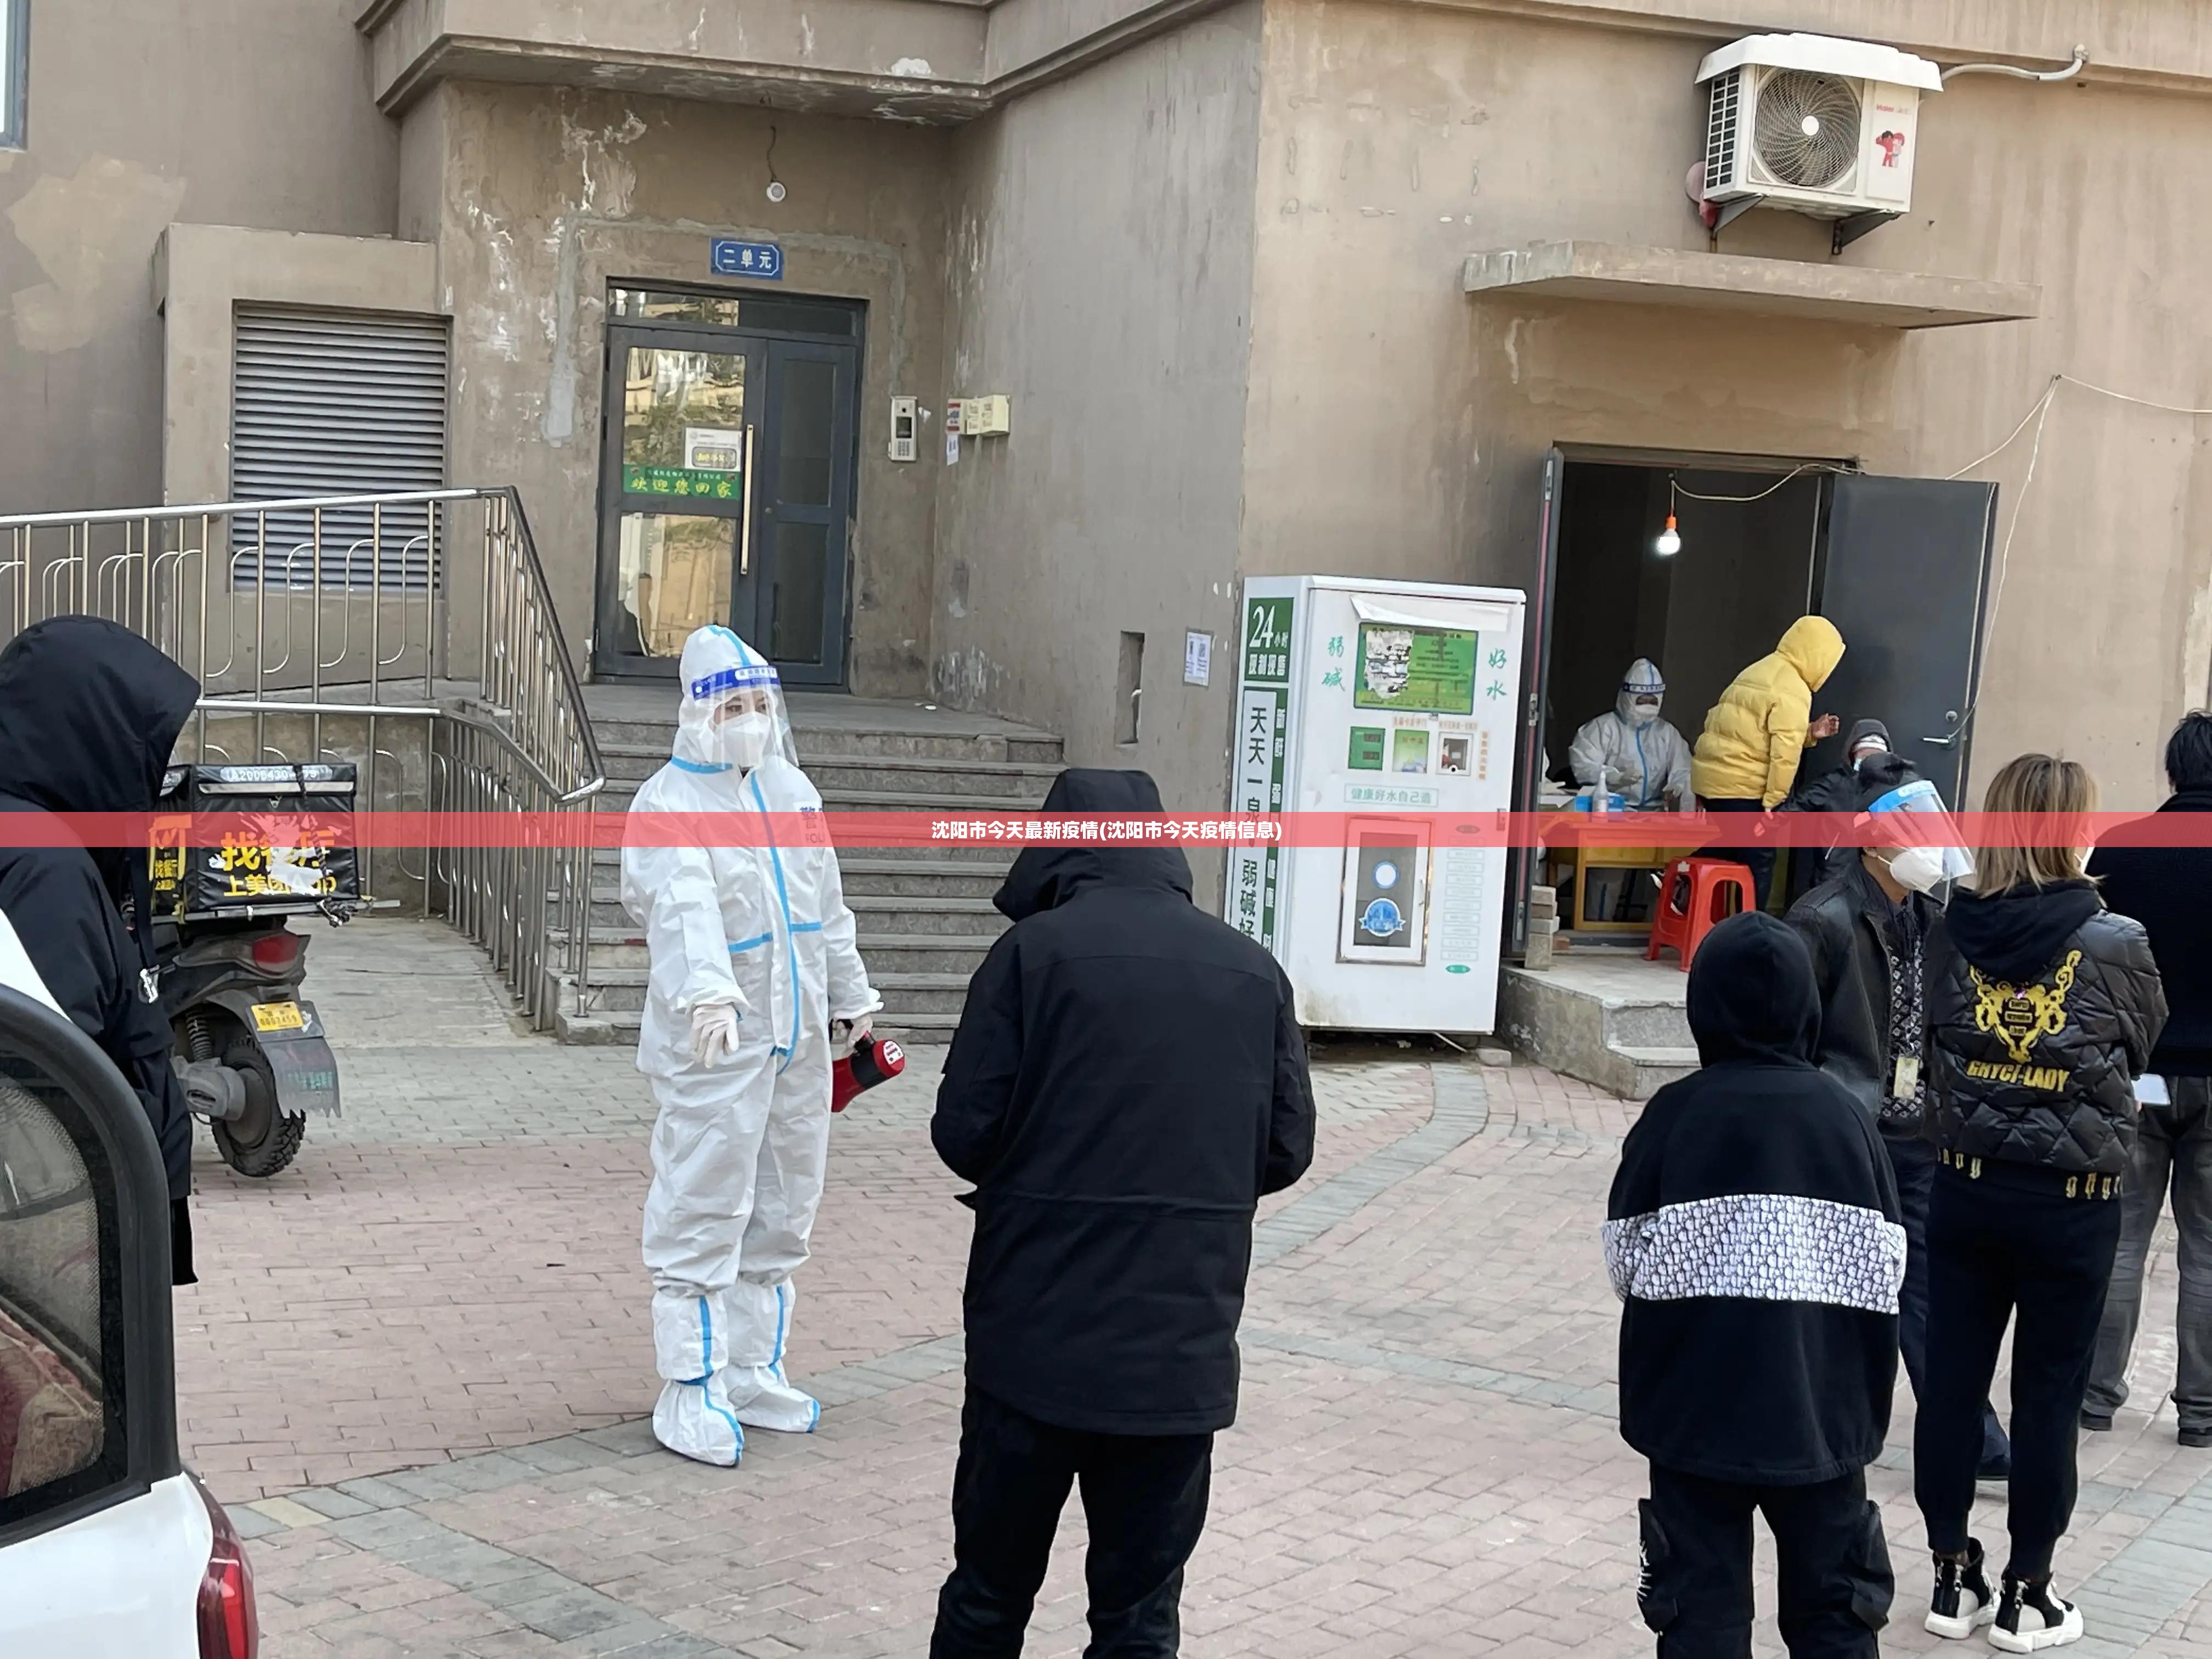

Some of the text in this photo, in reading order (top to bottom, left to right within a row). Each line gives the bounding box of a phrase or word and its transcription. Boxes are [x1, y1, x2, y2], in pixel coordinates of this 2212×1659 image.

[723, 249, 772, 269] 二单元
[631, 477, 732, 498] 欢迎您回家
[1351, 788, 1432, 805] 健康好水自己造
